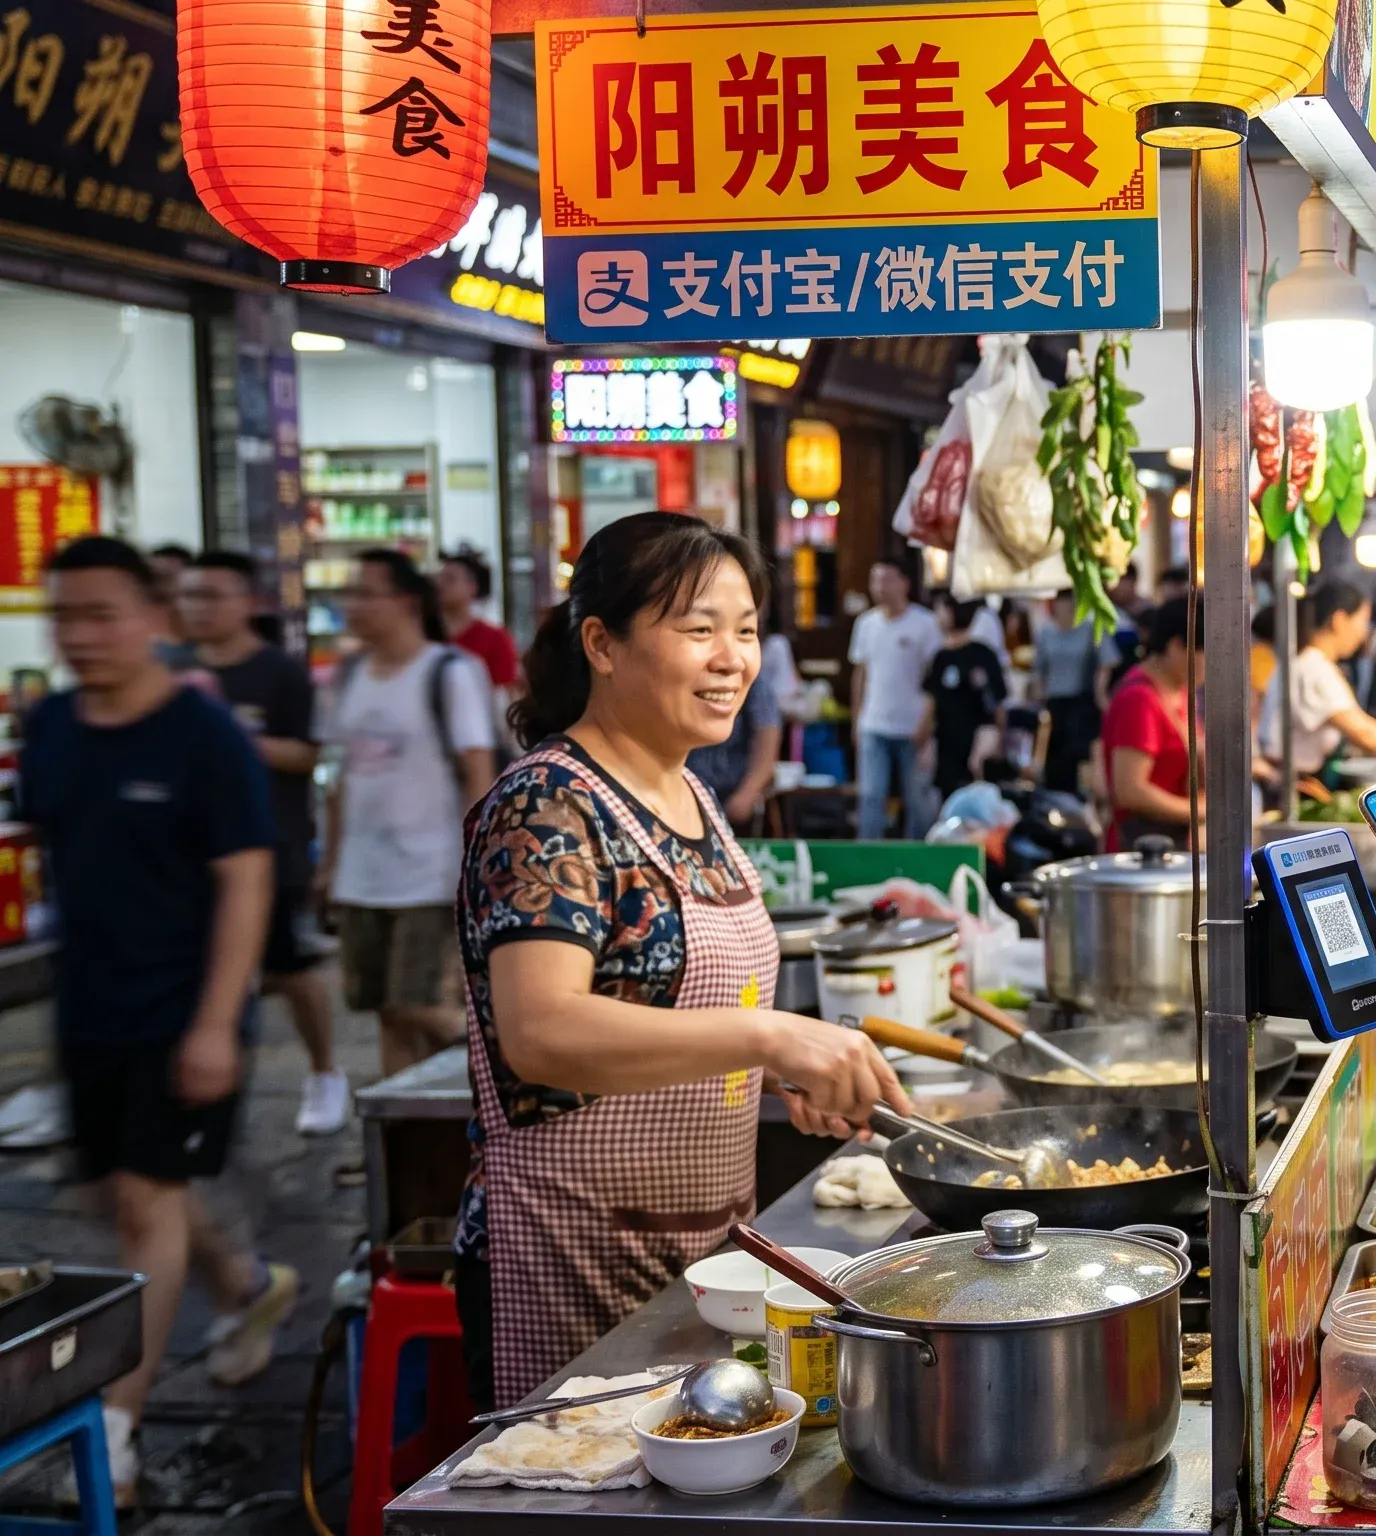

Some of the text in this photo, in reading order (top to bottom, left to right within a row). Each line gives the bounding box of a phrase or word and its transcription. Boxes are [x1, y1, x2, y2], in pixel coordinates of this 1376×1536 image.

[0, 8, 182, 173] 阳朔
[360, 0, 465, 160] 美食
[592, 38, 1098, 199] 阳朔美食
[662, 240, 1125, 319] 支付宝/微信支付
[564, 370, 725, 429] 阳朔美食
